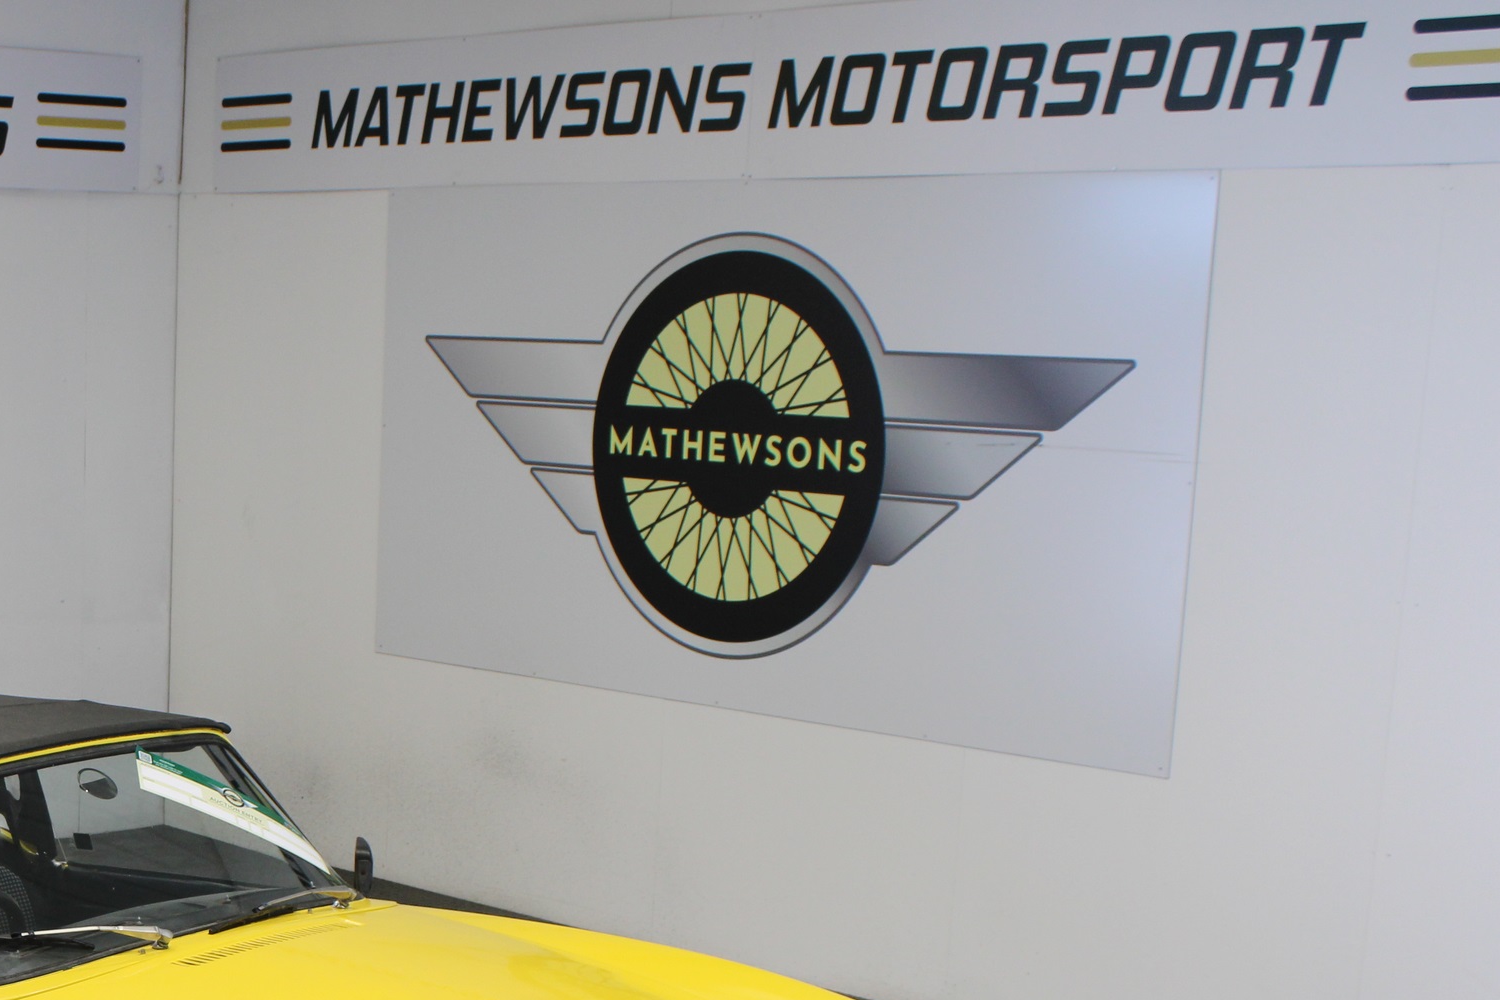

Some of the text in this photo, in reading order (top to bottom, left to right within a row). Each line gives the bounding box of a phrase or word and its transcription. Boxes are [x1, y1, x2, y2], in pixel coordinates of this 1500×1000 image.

[310, 21, 1368, 150] MATHEWSONS MOTORSPORT
[608, 424, 868, 474] MATHEWSONS
[209, 796, 241, 814] AUCTION
[241, 809, 263, 824] ENTRY
